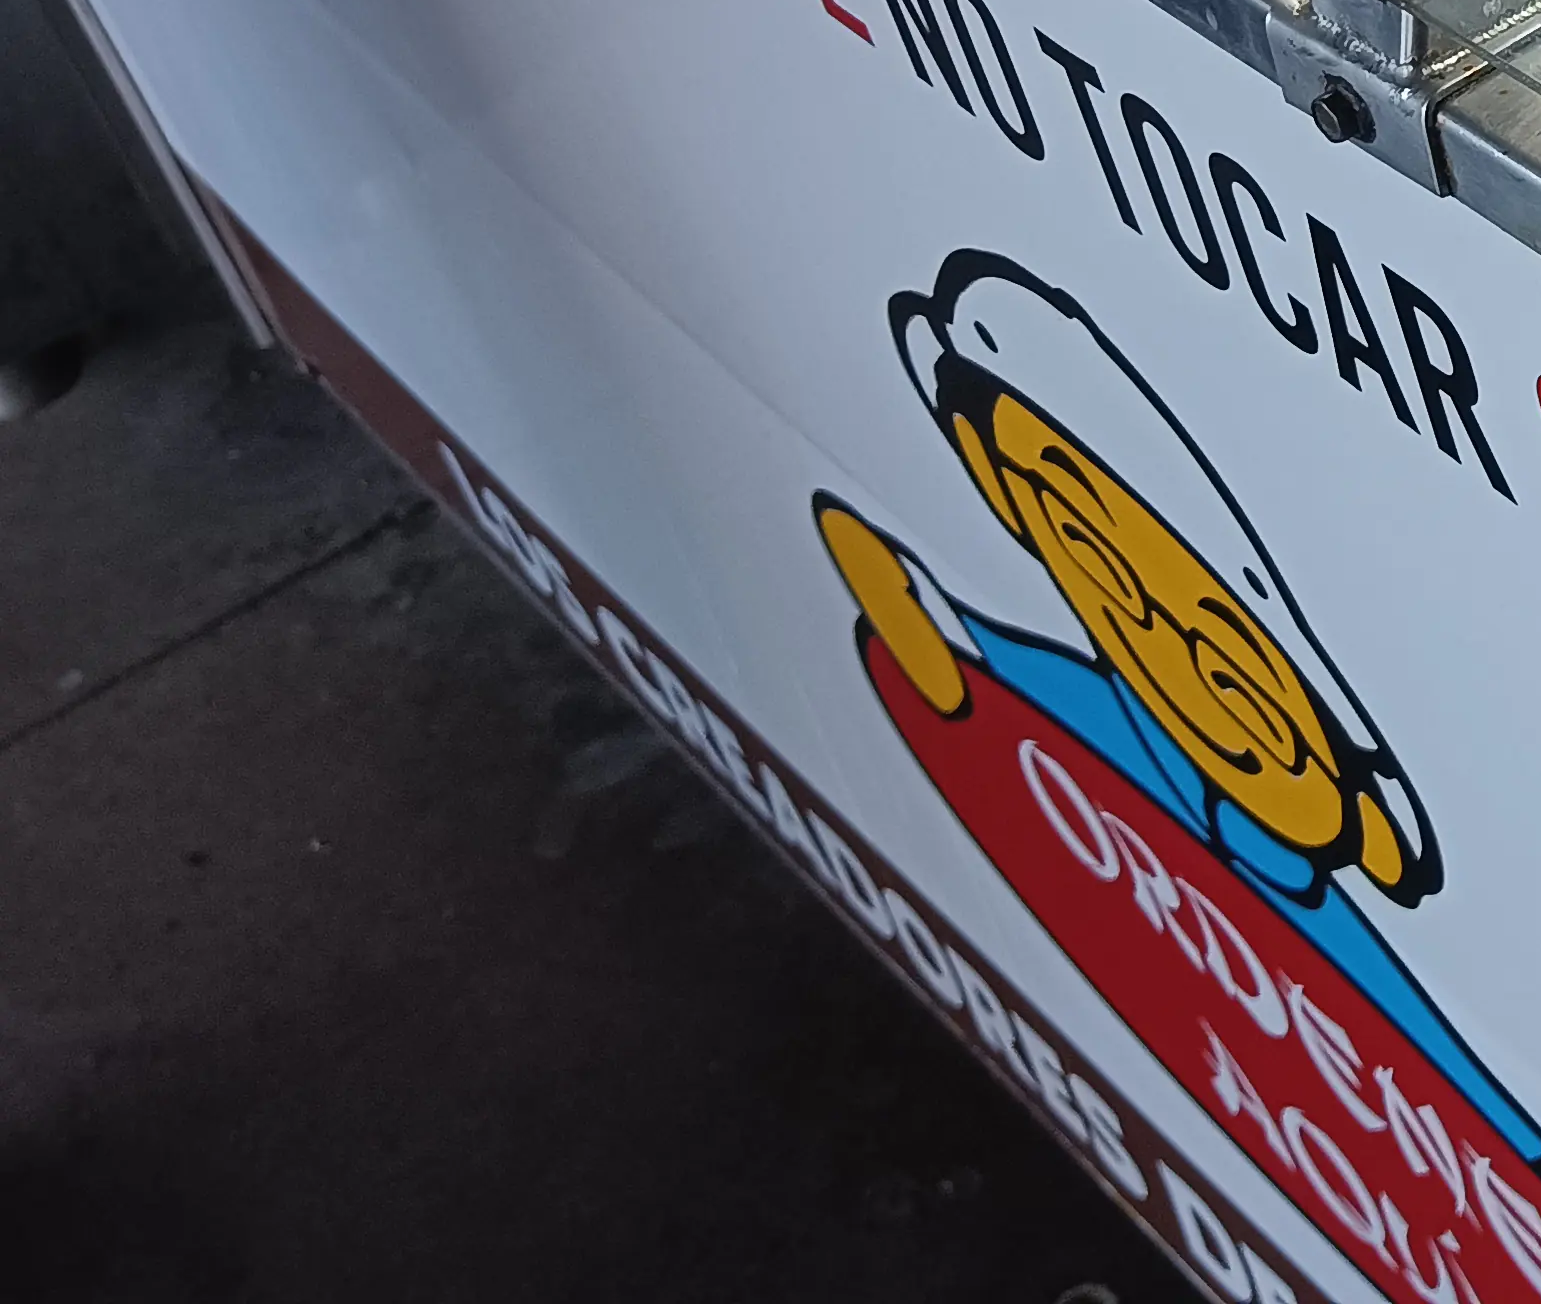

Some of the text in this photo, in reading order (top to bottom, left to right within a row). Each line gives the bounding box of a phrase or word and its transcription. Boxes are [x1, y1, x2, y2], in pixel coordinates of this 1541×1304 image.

[1033, 26, 1519, 506] TOCAR
[437, 439, 600, 646] LOS
[596, 604, 1149, 1201] CREADORES
